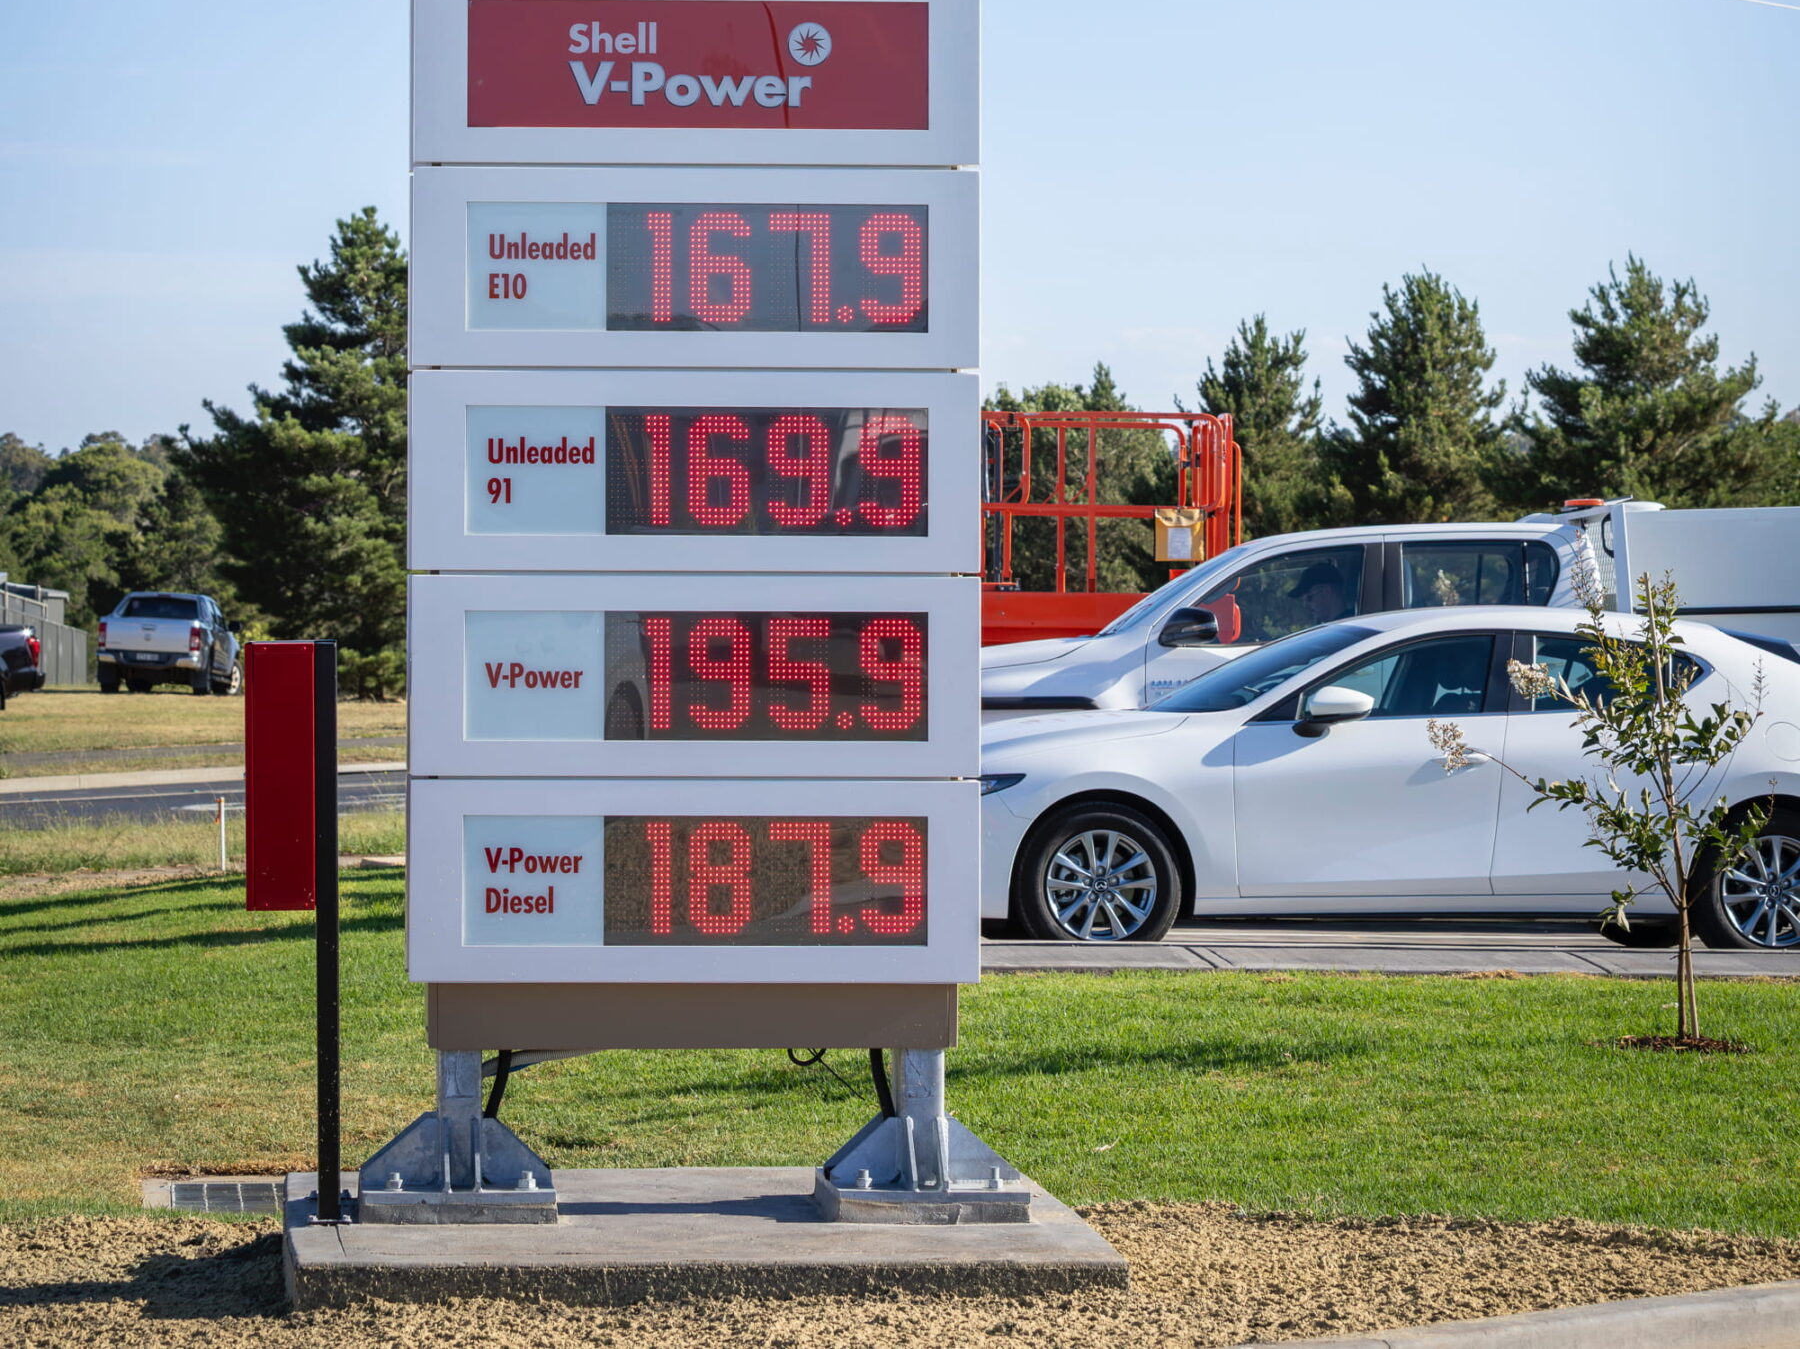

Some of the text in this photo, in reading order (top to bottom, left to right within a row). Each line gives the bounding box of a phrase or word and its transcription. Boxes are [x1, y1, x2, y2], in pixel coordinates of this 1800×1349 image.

[568, 20, 657, 54] Shell
[569, 61, 812, 107] V-Power
[488, 233, 596, 260] Unleaded
[647, 212, 922, 323] 167.9
[488, 274, 527, 299] E10
[487, 437, 595, 464] Unleaded
[645, 415, 921, 527] 169.9
[487, 478, 512, 504] 91
[485, 662, 583, 689] V-Power
[646, 618, 922, 730] 195.9
[485, 847, 582, 874] V-Power
[646, 822, 923, 935] 187.9
[485, 886, 554, 914] Diesel
